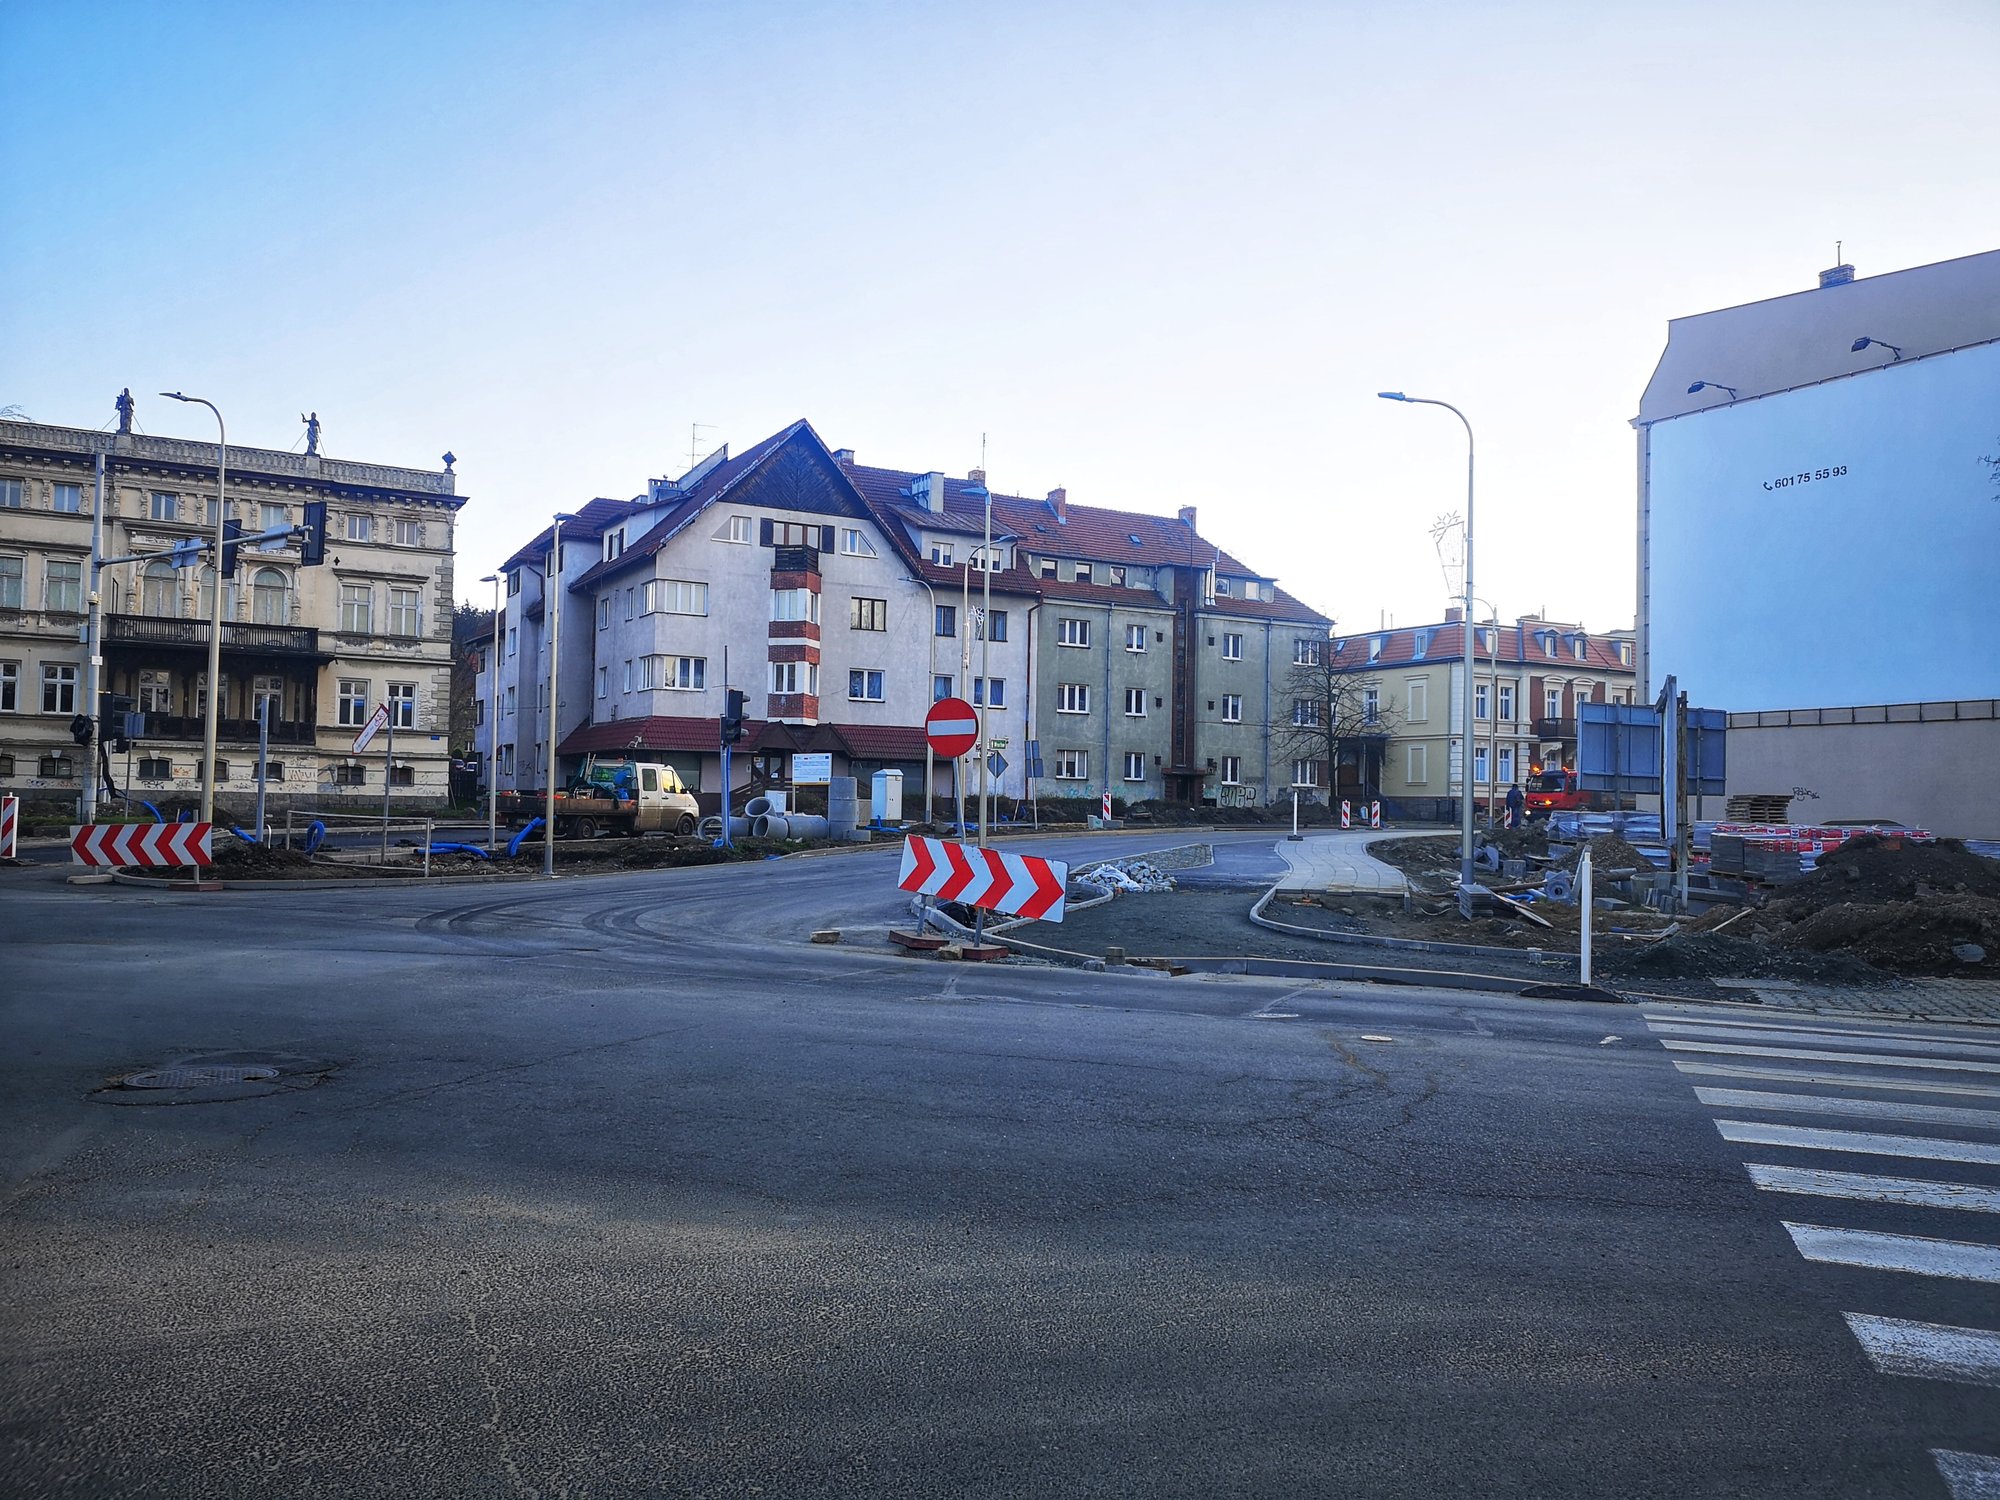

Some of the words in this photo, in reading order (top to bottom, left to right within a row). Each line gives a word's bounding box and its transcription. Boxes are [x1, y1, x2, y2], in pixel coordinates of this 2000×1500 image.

[1775, 477, 1794, 489] 601
[1797, 473, 1811, 484] 75
[1815, 469, 1830, 480] 55
[1832, 465, 1847, 477] 93
